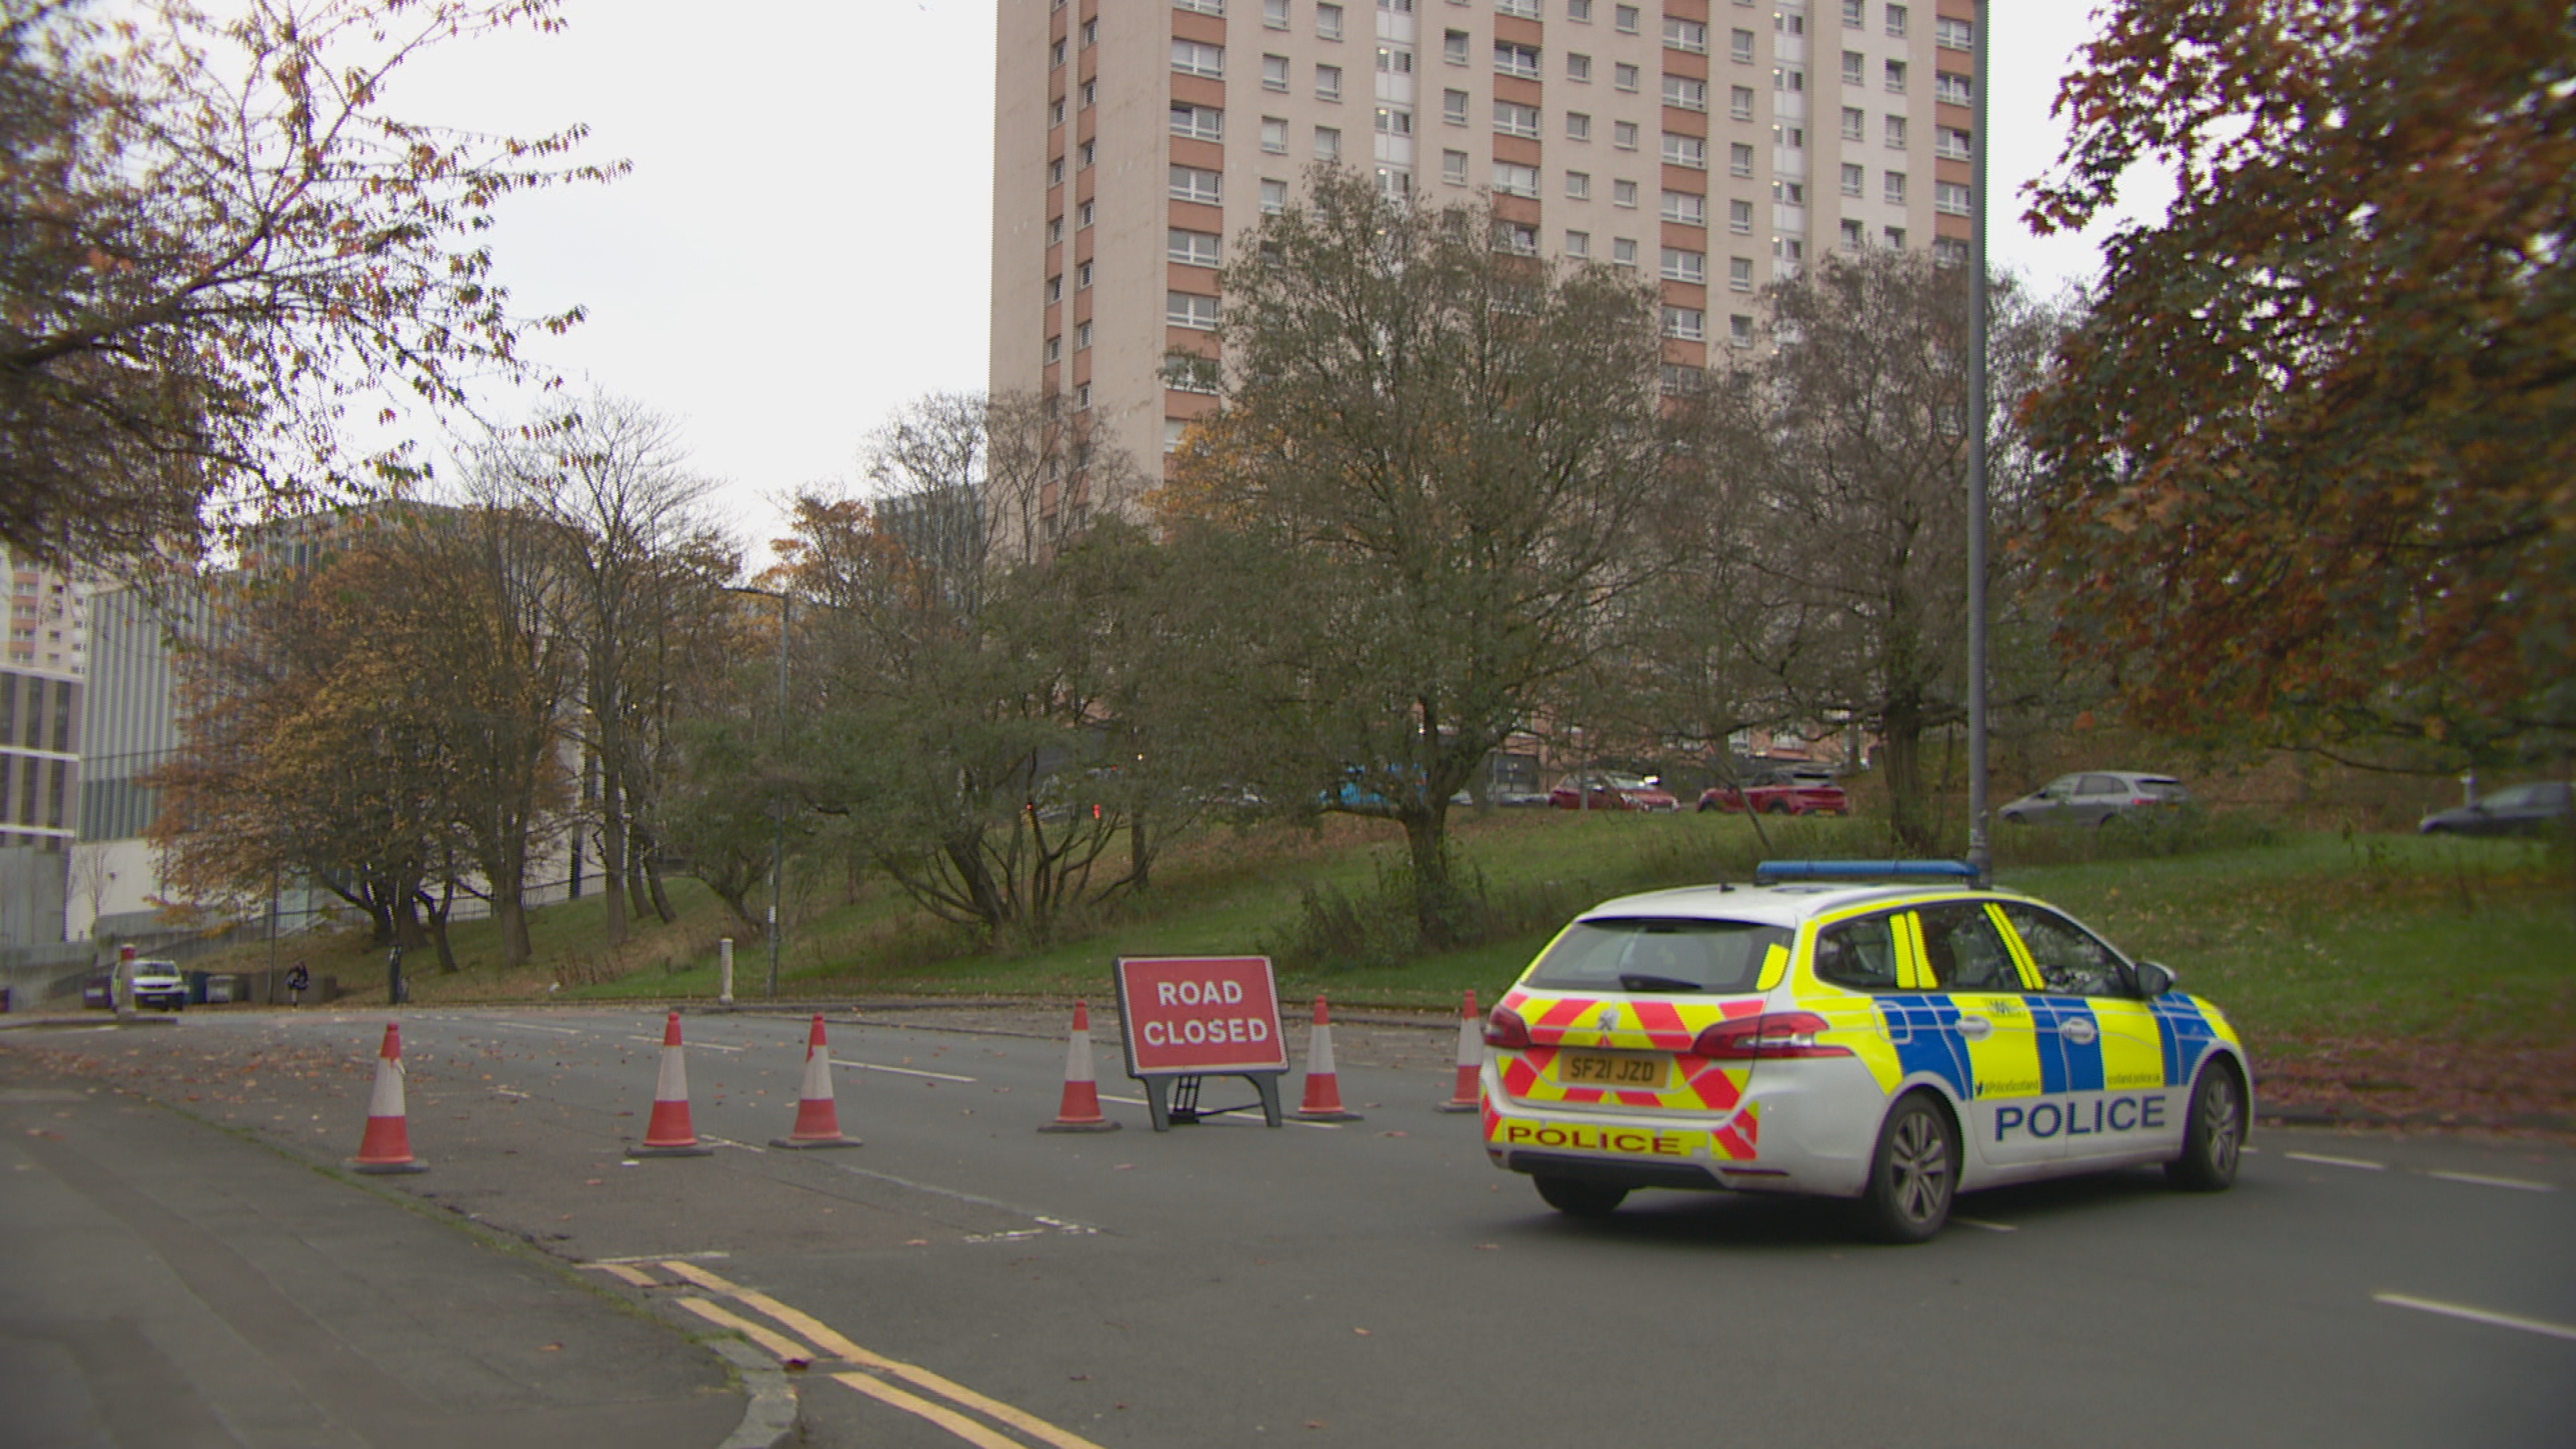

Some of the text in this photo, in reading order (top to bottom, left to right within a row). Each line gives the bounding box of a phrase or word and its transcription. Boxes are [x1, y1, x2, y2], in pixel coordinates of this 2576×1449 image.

[1157, 981, 1242, 1006] ROAD
[1144, 1018, 1267, 1046] CLOSED
[1571, 1057, 1654, 1081] SF21 JZD
[1995, 1095, 2165, 1142] POLICE
[1507, 1126, 1680, 1155] POLICE
